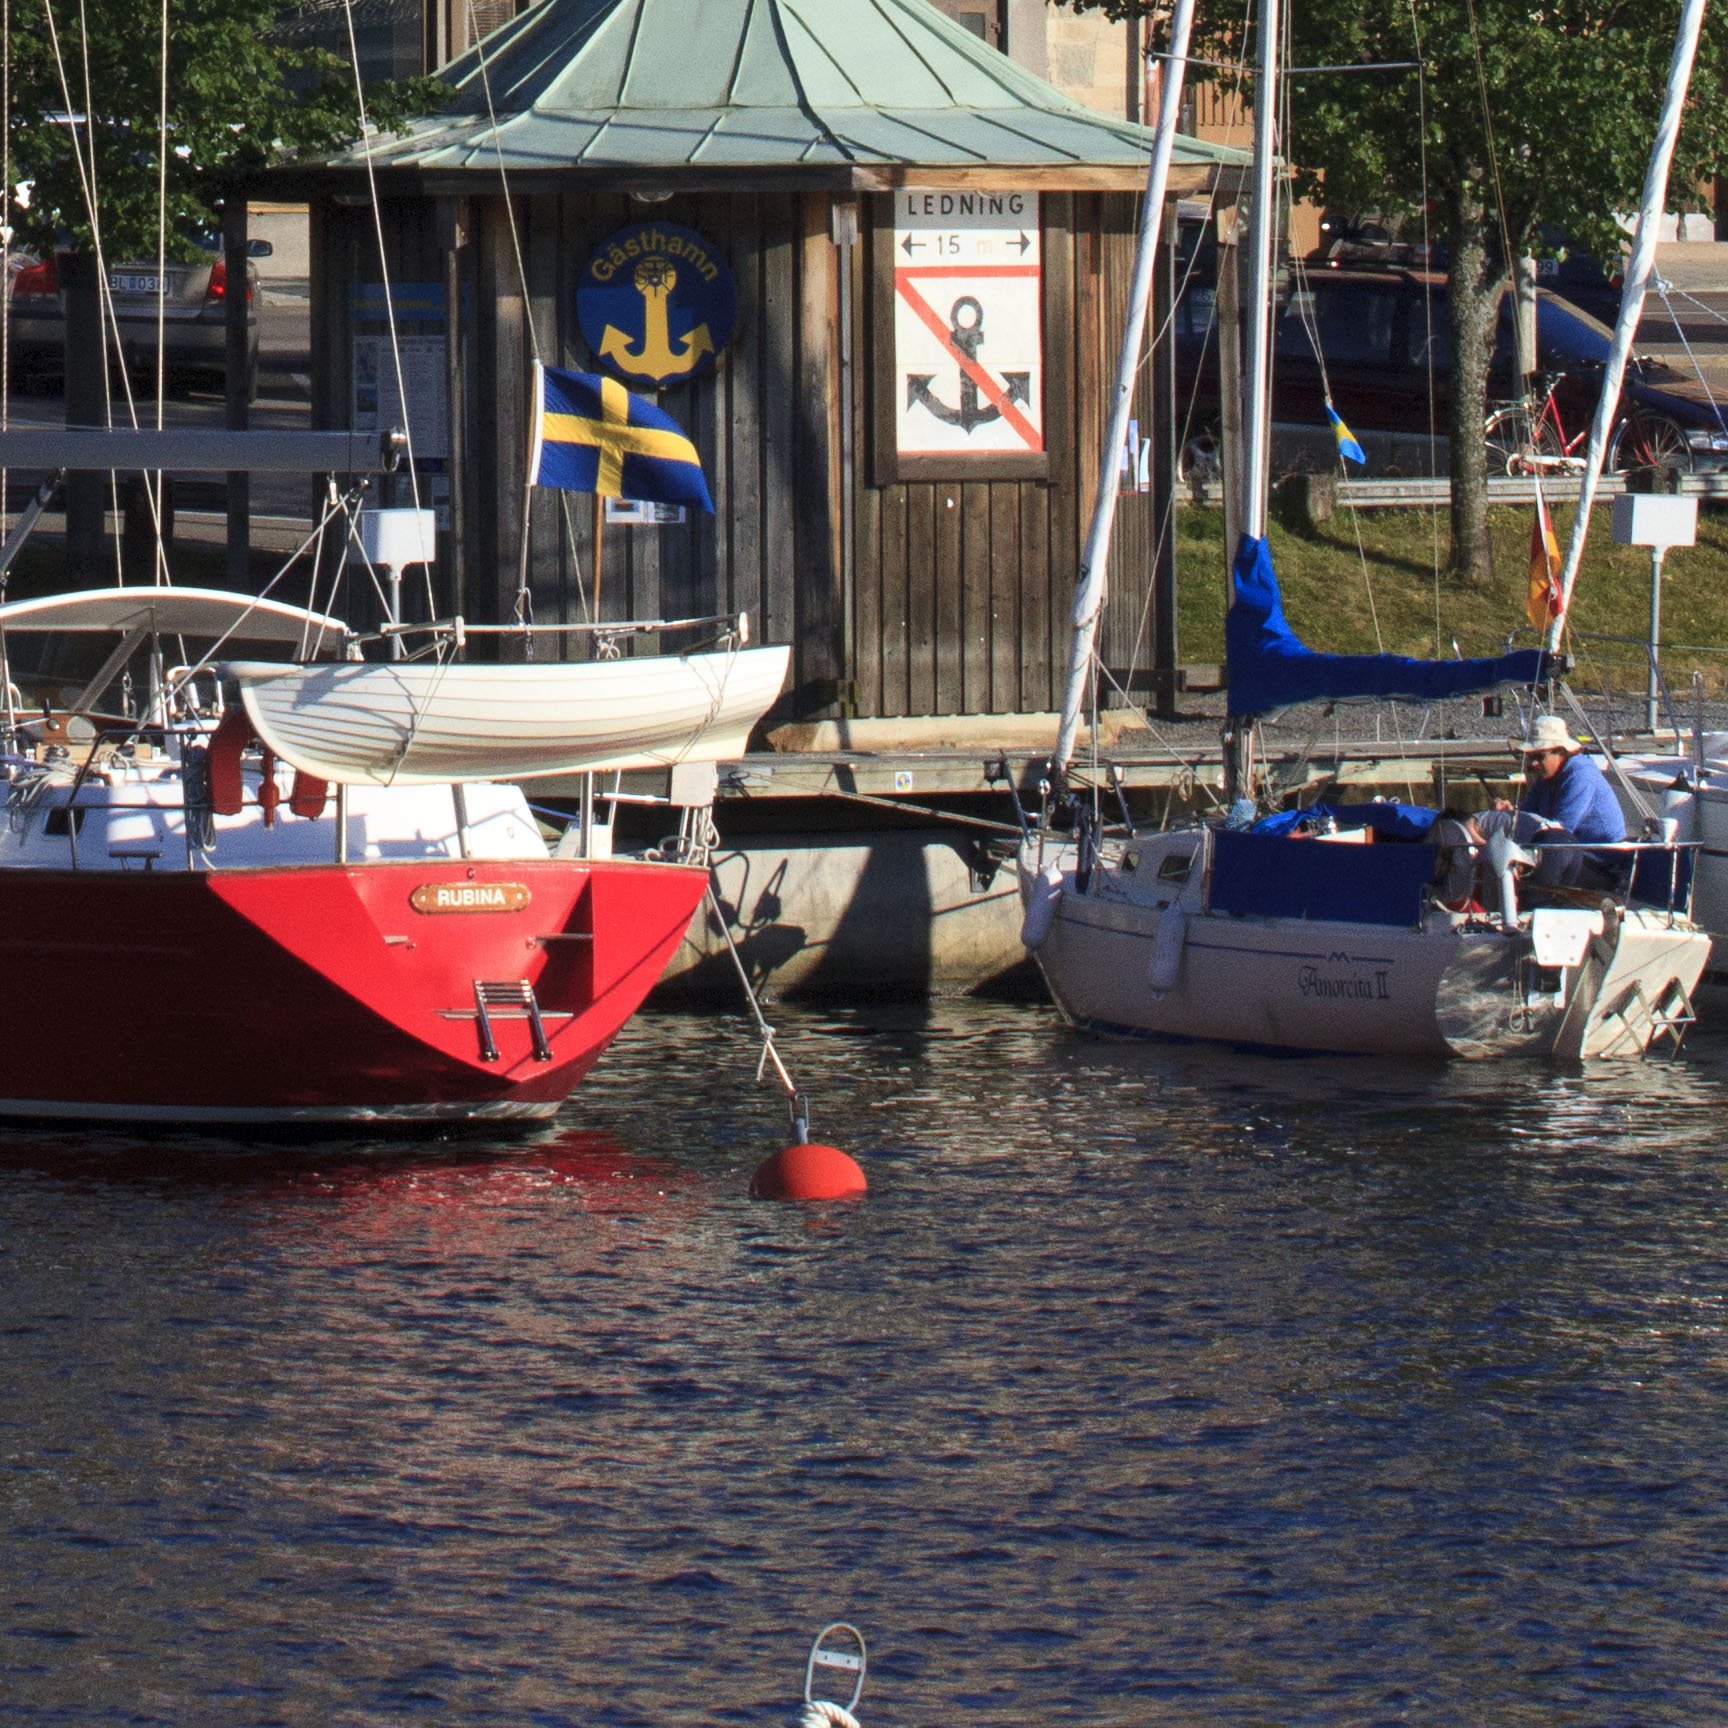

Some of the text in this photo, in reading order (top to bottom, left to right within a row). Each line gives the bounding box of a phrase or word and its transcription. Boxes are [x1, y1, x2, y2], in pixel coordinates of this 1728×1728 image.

[907, 194, 1025, 216] LEDNING
[591, 228, 720, 283] Gästhamn
[936, 234, 961, 255] 15
[437, 888, 506, 907] RUBINA
[1375, 971, 1390, 999] II
